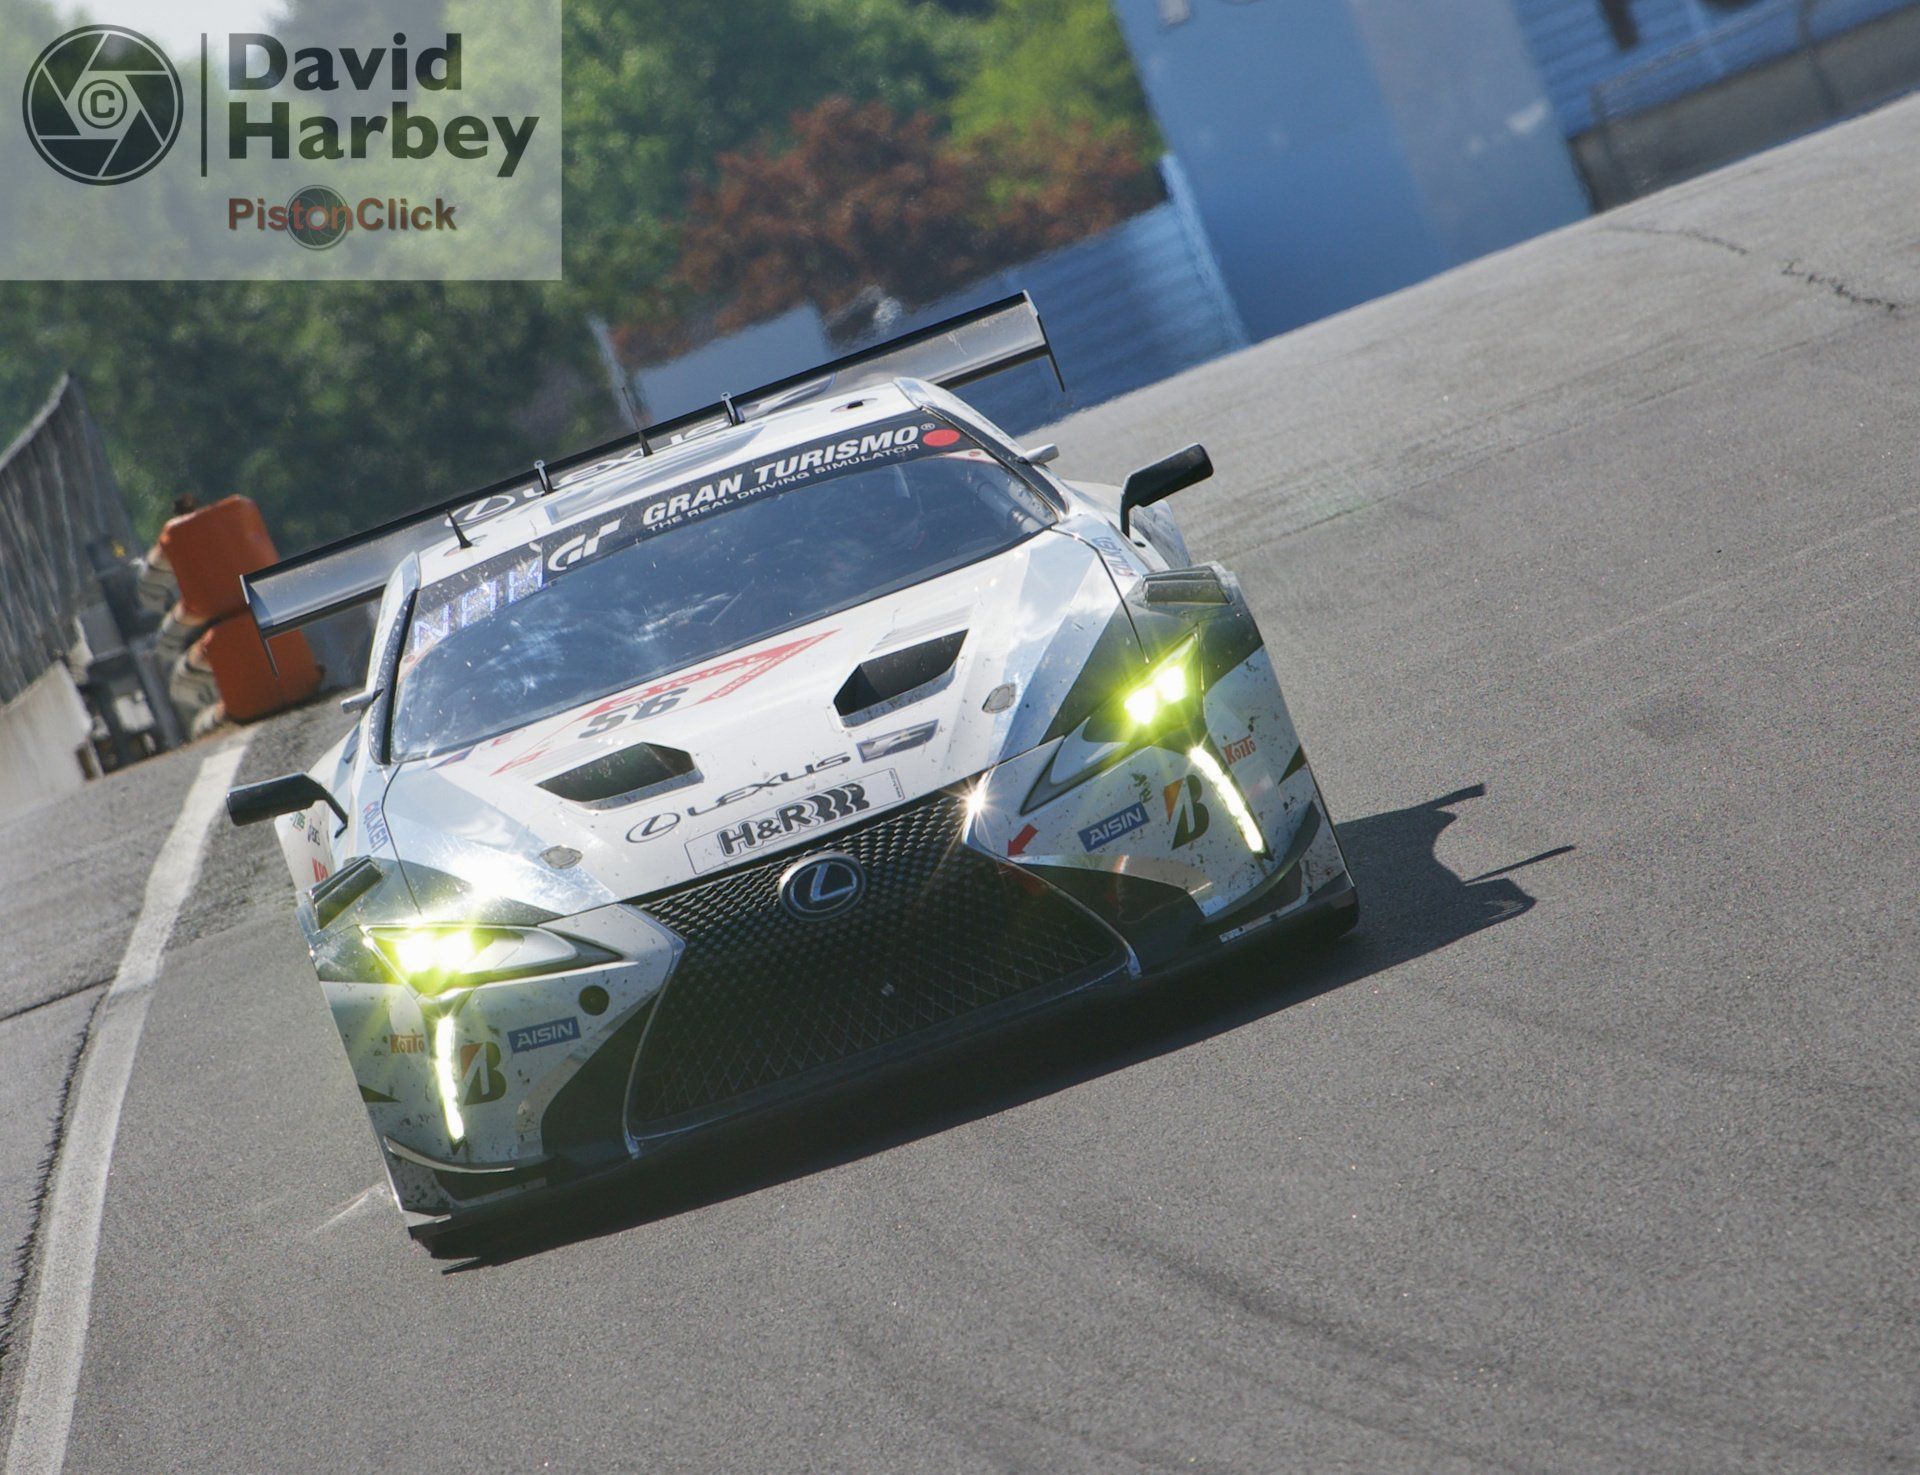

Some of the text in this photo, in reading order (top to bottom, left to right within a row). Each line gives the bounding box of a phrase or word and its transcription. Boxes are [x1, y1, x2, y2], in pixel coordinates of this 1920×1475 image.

[523, 418, 731, 498] LEXUS
[643, 473, 745, 525] GRAN
[648, 443, 920, 533] THE REAL DRIVING SIMULATOR
[656, 653, 765, 691] TOTAL
[578, 687, 689, 738] 56
[687, 751, 851, 817] LEXUS
[717, 800, 822, 857] H&R
[1089, 806, 1143, 846] AISIN
[516, 1021, 574, 1049] AISIN
